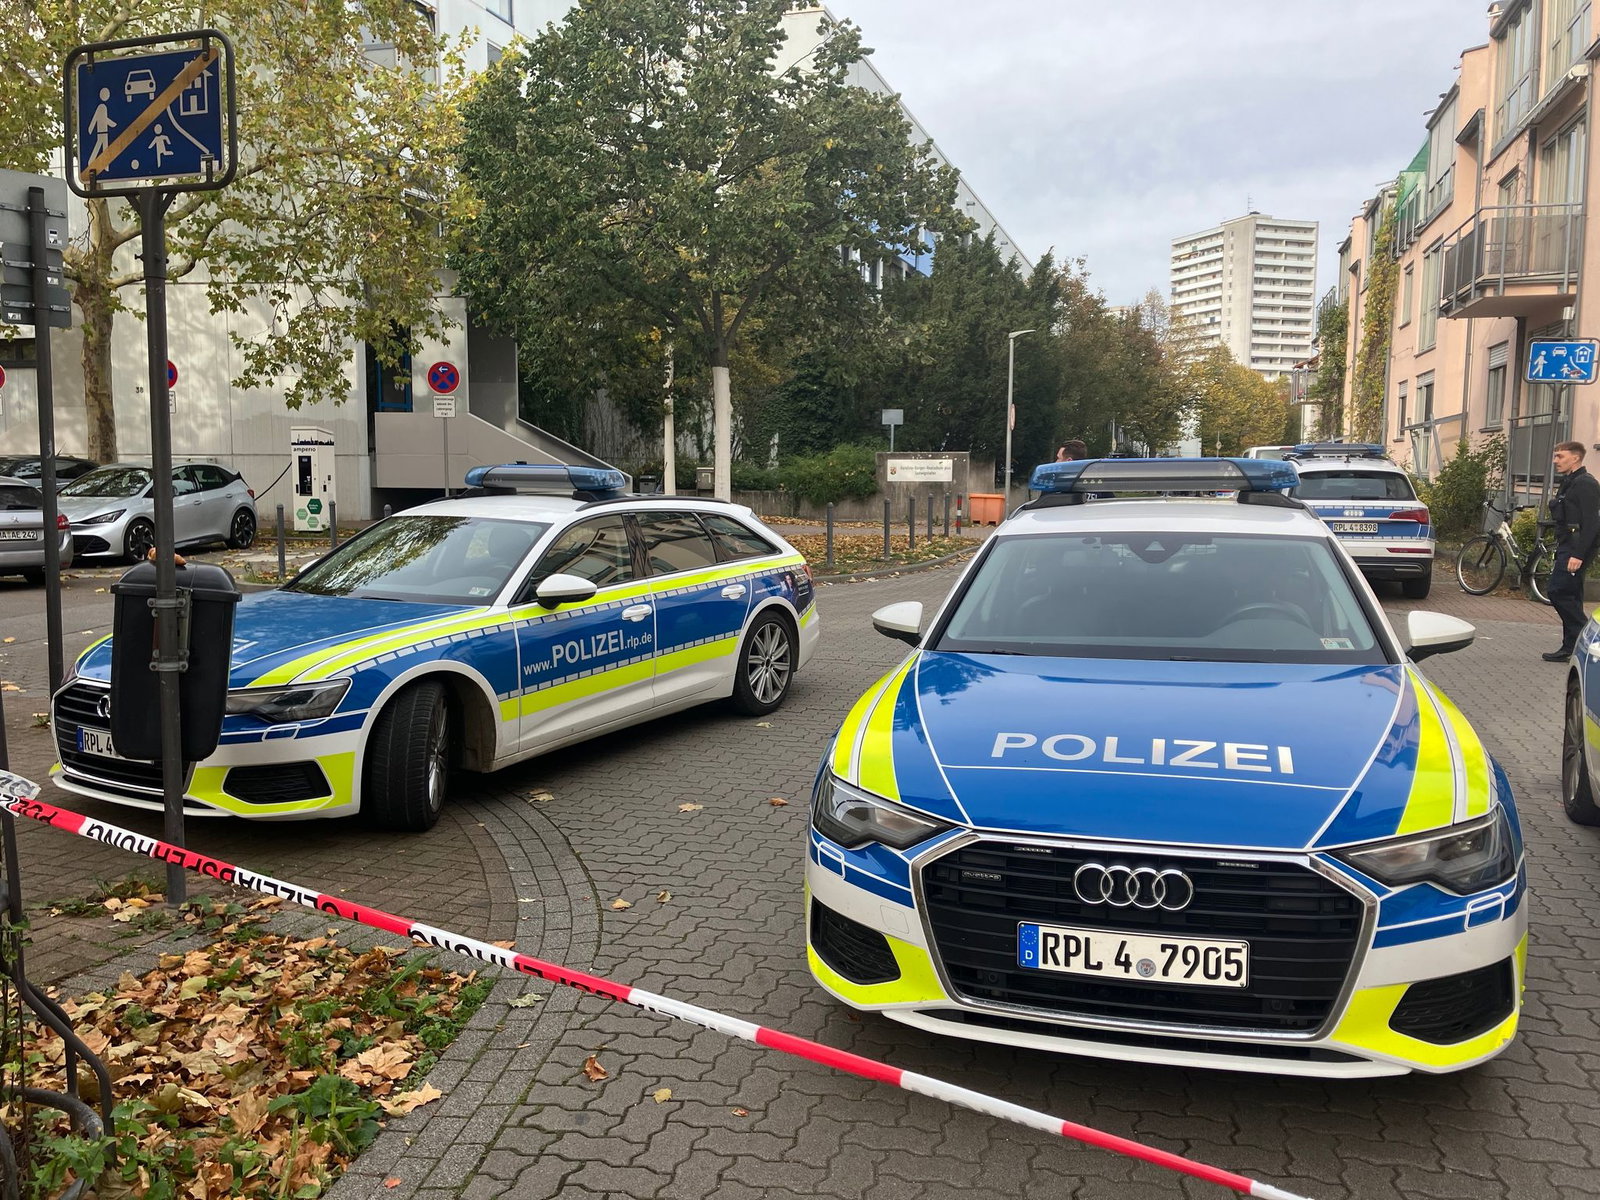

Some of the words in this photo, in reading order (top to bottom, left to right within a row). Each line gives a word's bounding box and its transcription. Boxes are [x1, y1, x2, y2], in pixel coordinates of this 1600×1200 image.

[1333, 524, 1347, 532] RPL
[1349, 523, 1354, 532] 4
[1359, 523, 1377, 532] 8398
[523, 629, 653, 676] www.POLIZEI.rlp.de
[84, 731, 104, 753] RPL
[106, 736, 112, 755] 4
[990, 732, 1295, 775] POLIZEI
[1024, 950, 1034, 960] D
[1042, 931, 1103, 971] RPL
[1114, 940, 1133, 974] 4
[1160, 943, 1244, 982] 7905
